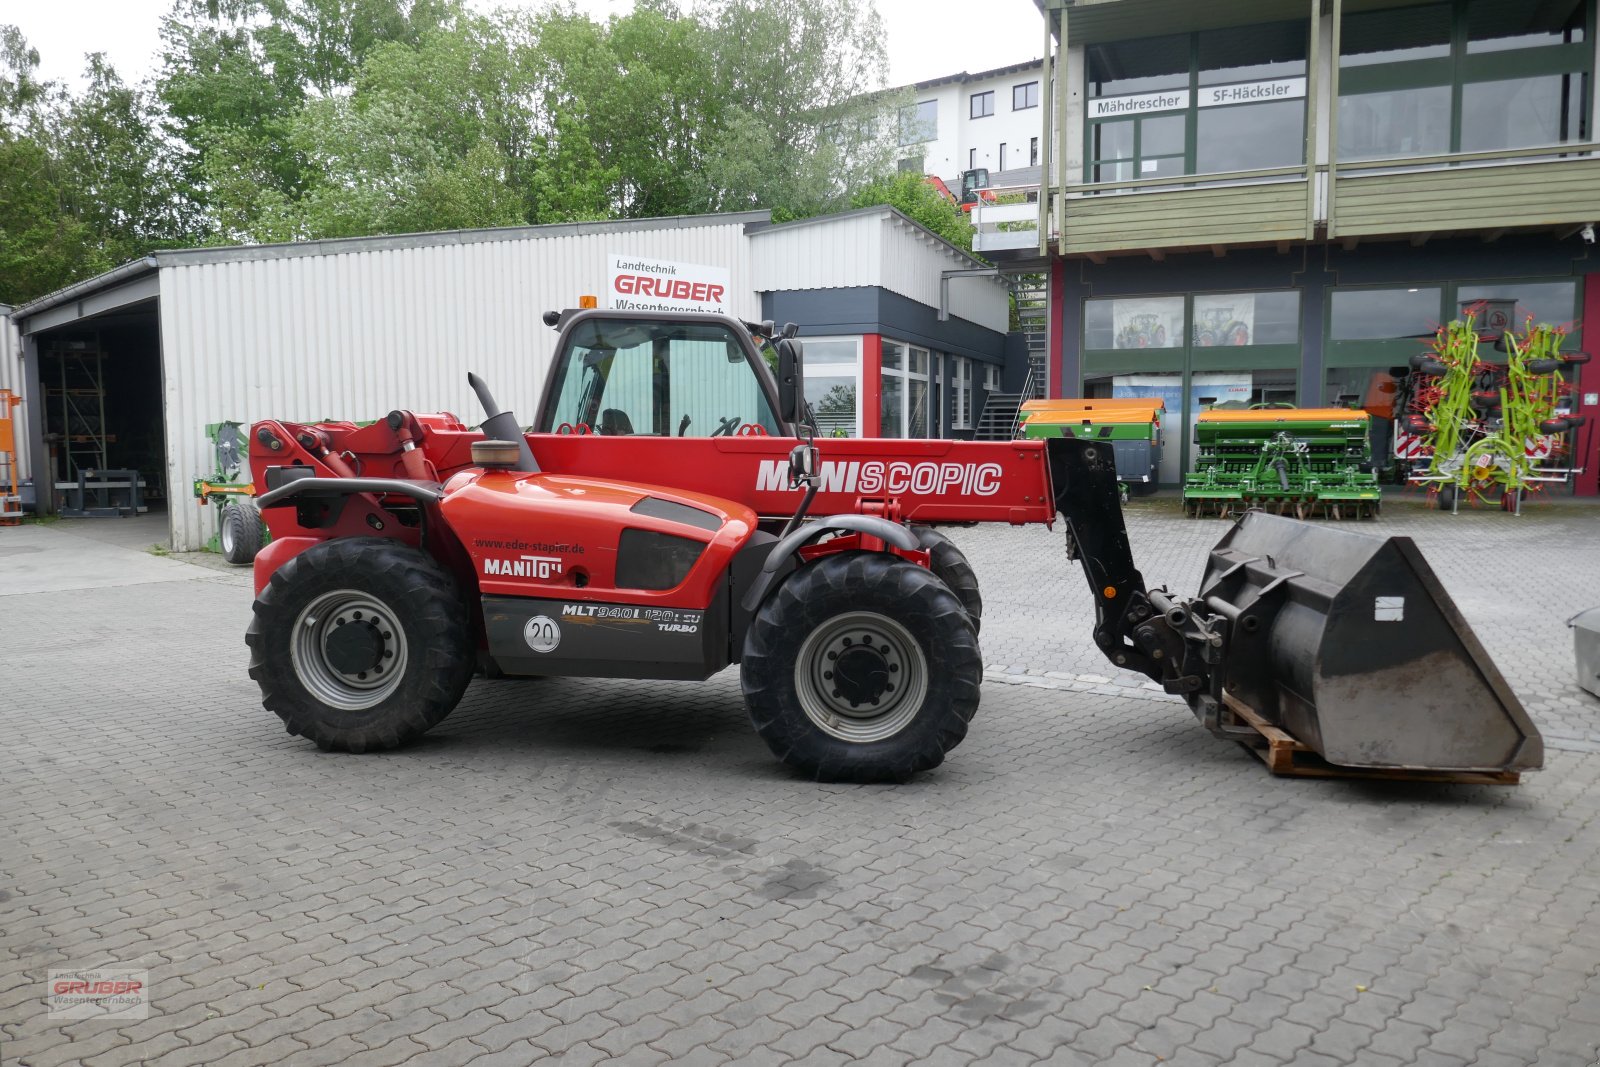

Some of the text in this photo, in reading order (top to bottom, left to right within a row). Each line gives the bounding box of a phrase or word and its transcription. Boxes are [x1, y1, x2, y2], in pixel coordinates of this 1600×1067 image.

[1213, 84, 1290, 101] SF-Häcksler
[1098, 95, 1181, 114] Mähdrescher
[616, 259, 677, 275] Landtechnik
[614, 274, 725, 303] GRUBER
[531, 622, 554, 646] 20
[658, 623, 698, 634] TURBO
